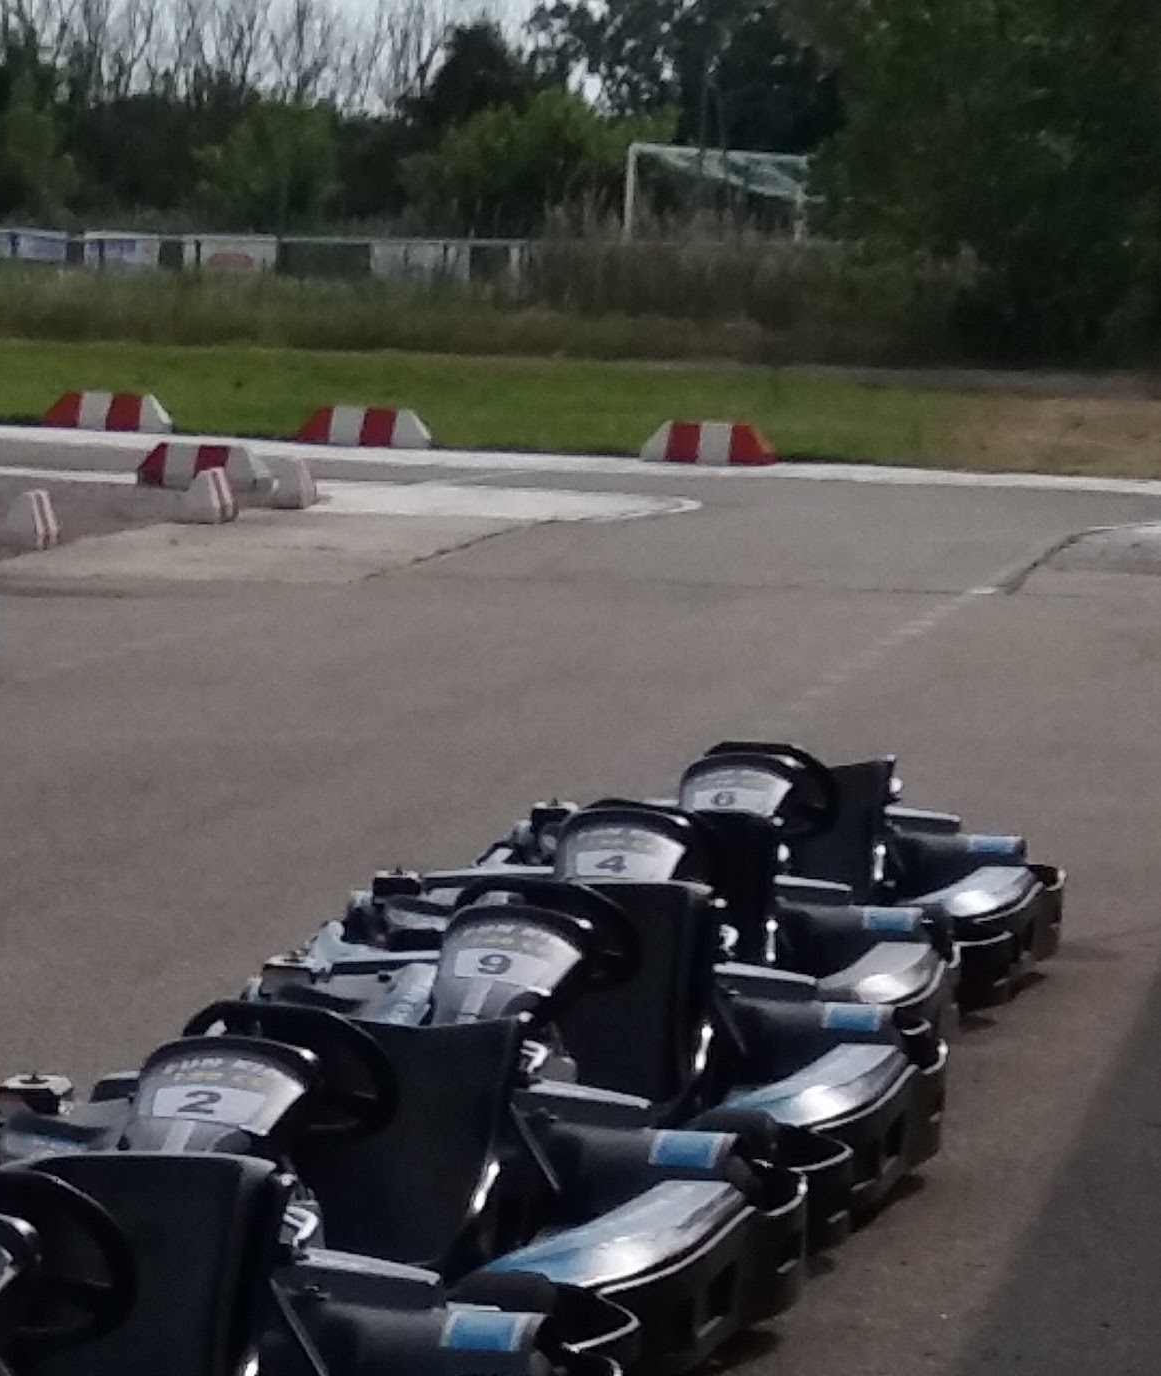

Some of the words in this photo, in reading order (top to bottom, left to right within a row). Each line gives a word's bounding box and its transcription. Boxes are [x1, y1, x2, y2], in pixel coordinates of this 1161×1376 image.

[594, 854, 628, 874] 4
[477, 953, 512, 975] 9
[176, 1089, 223, 1115] 2
